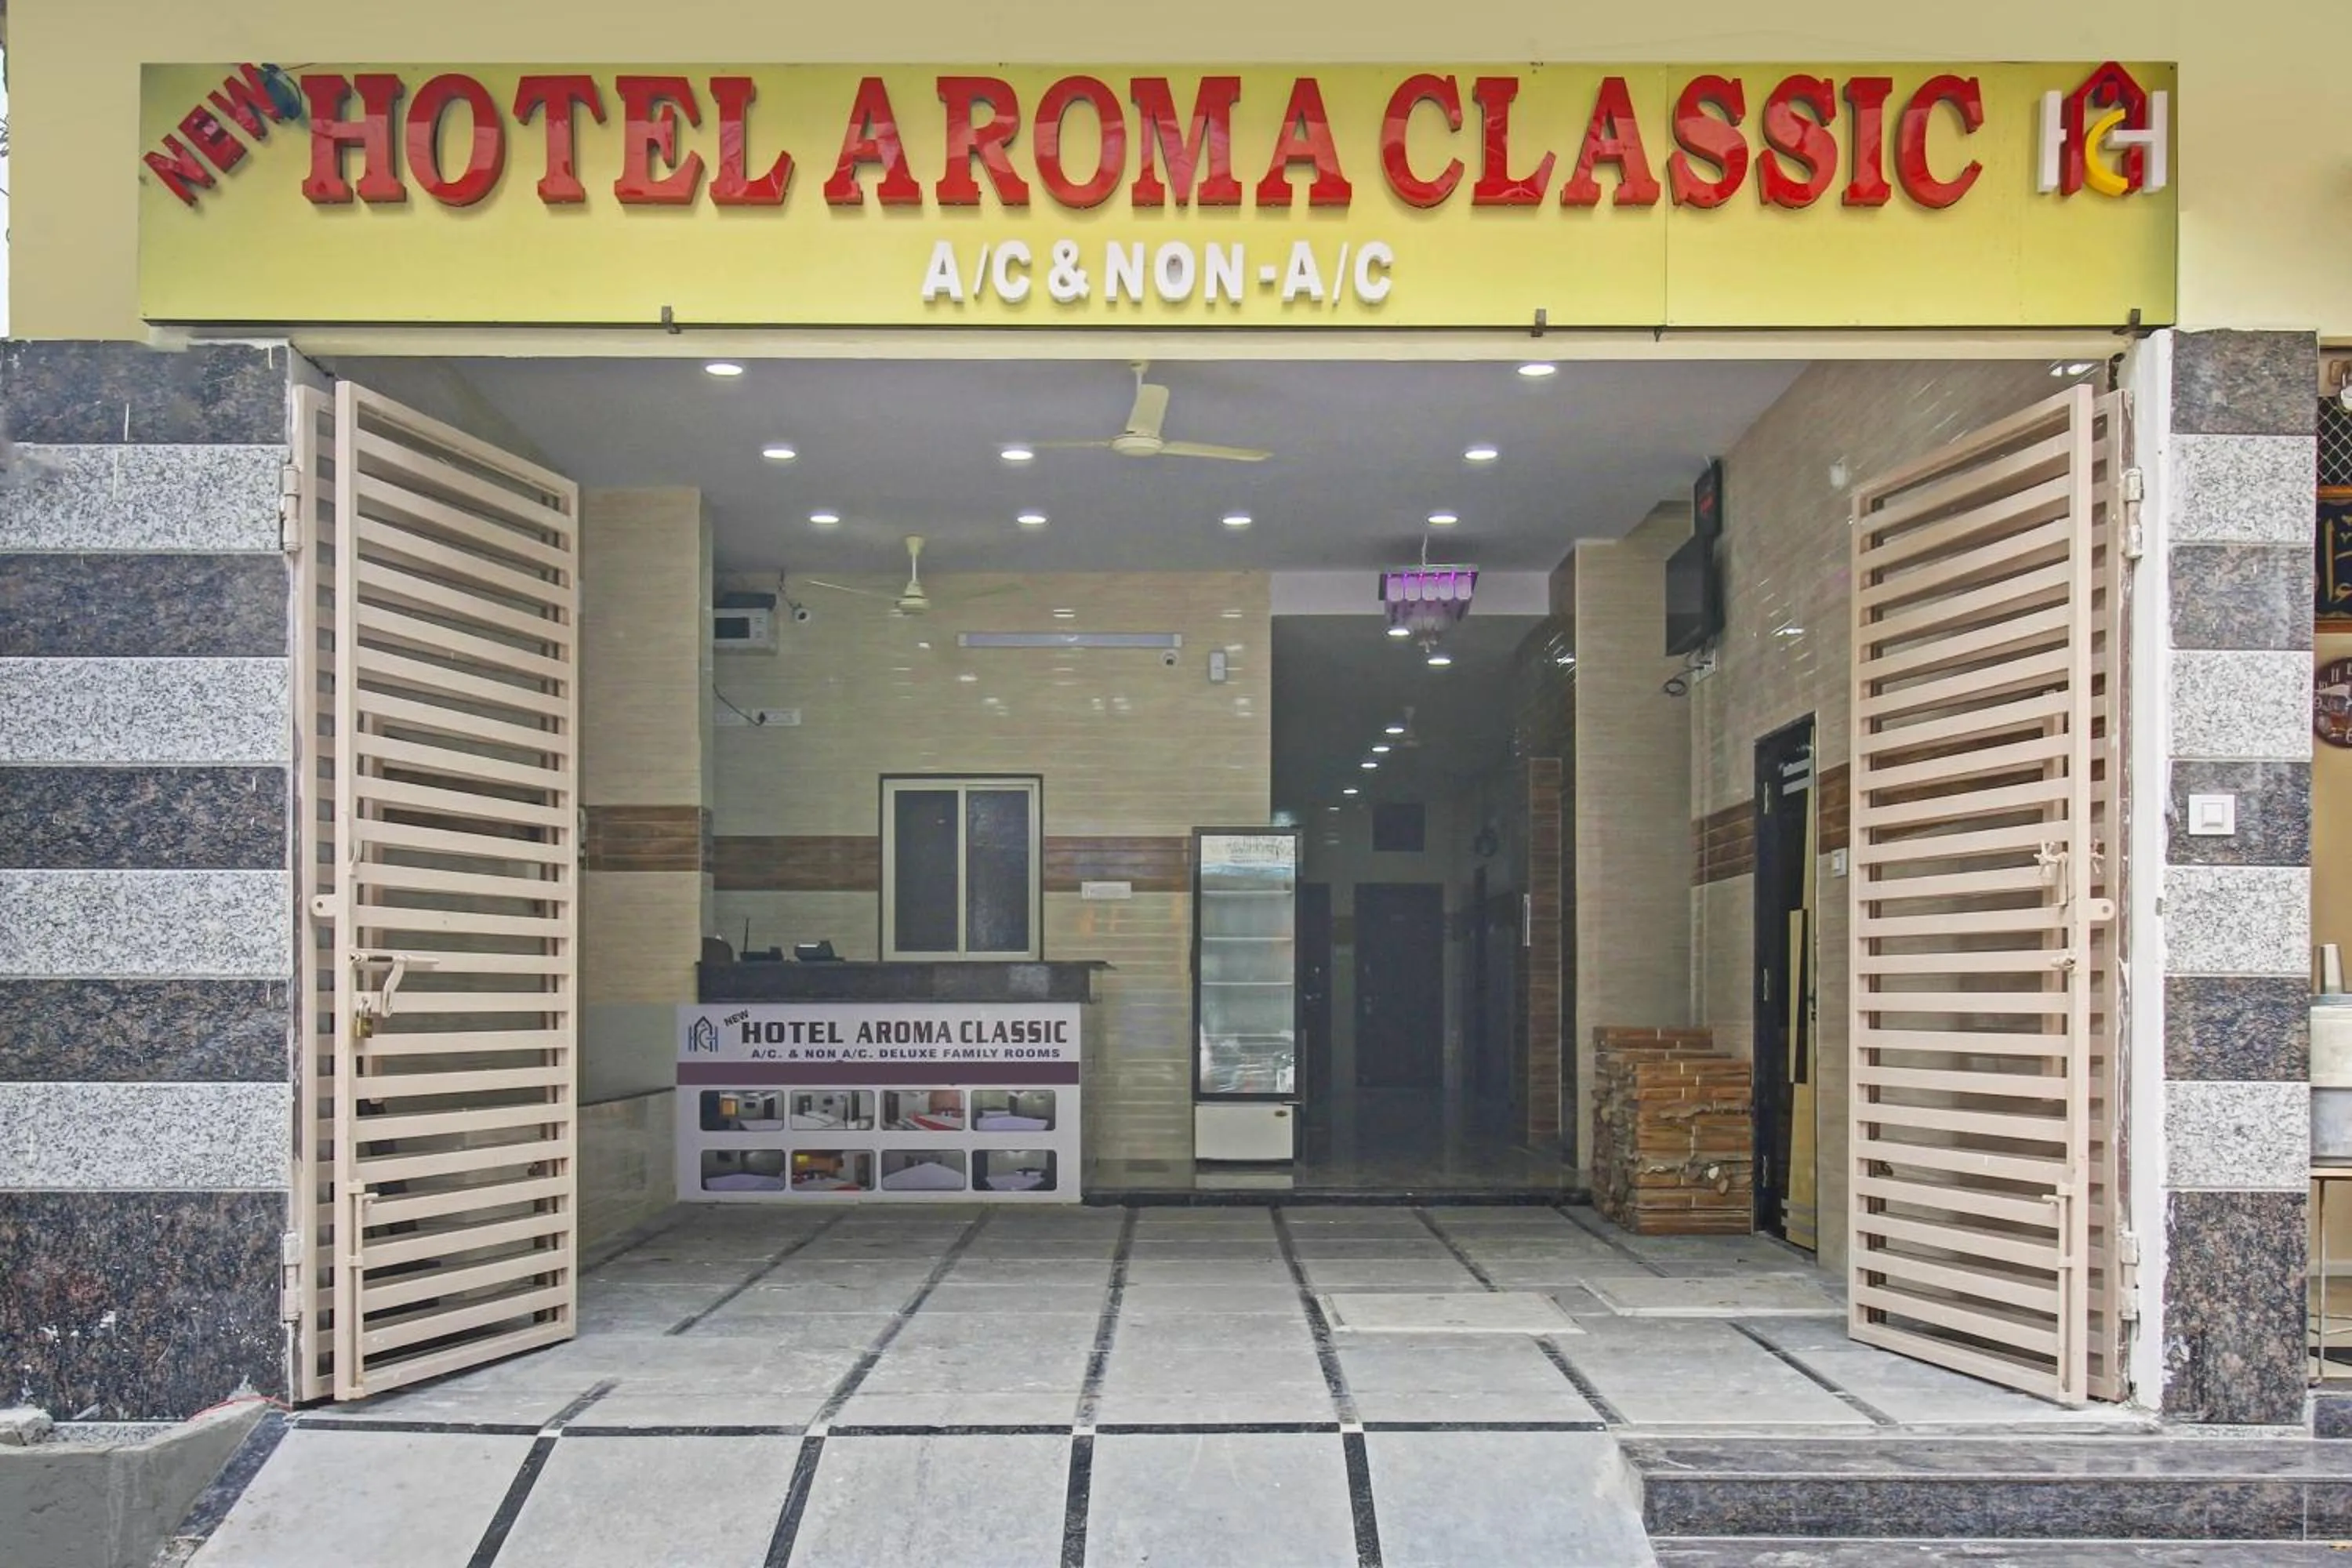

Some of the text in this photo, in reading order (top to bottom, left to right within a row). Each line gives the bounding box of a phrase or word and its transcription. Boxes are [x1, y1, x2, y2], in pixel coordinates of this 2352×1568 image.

[143, 63, 285, 207] NEW
[300, 73, 1985, 209] HOTEL AROMA CLASSIC
[922, 240, 1031, 304] A/C
[1047, 240, 1091, 304] &
[723, 1008, 750, 1028] NEW
[741, 1020, 1067, 1044] HOTEL AROMA CLASSIC
[789, 1049, 799, 1058] &
[805, 1049, 837, 1058] NON
[880, 1049, 937, 1058] DELUXE
[944, 1048, 999, 1058] FAMILY
[1005, 1048, 1061, 1058] ROOMS
